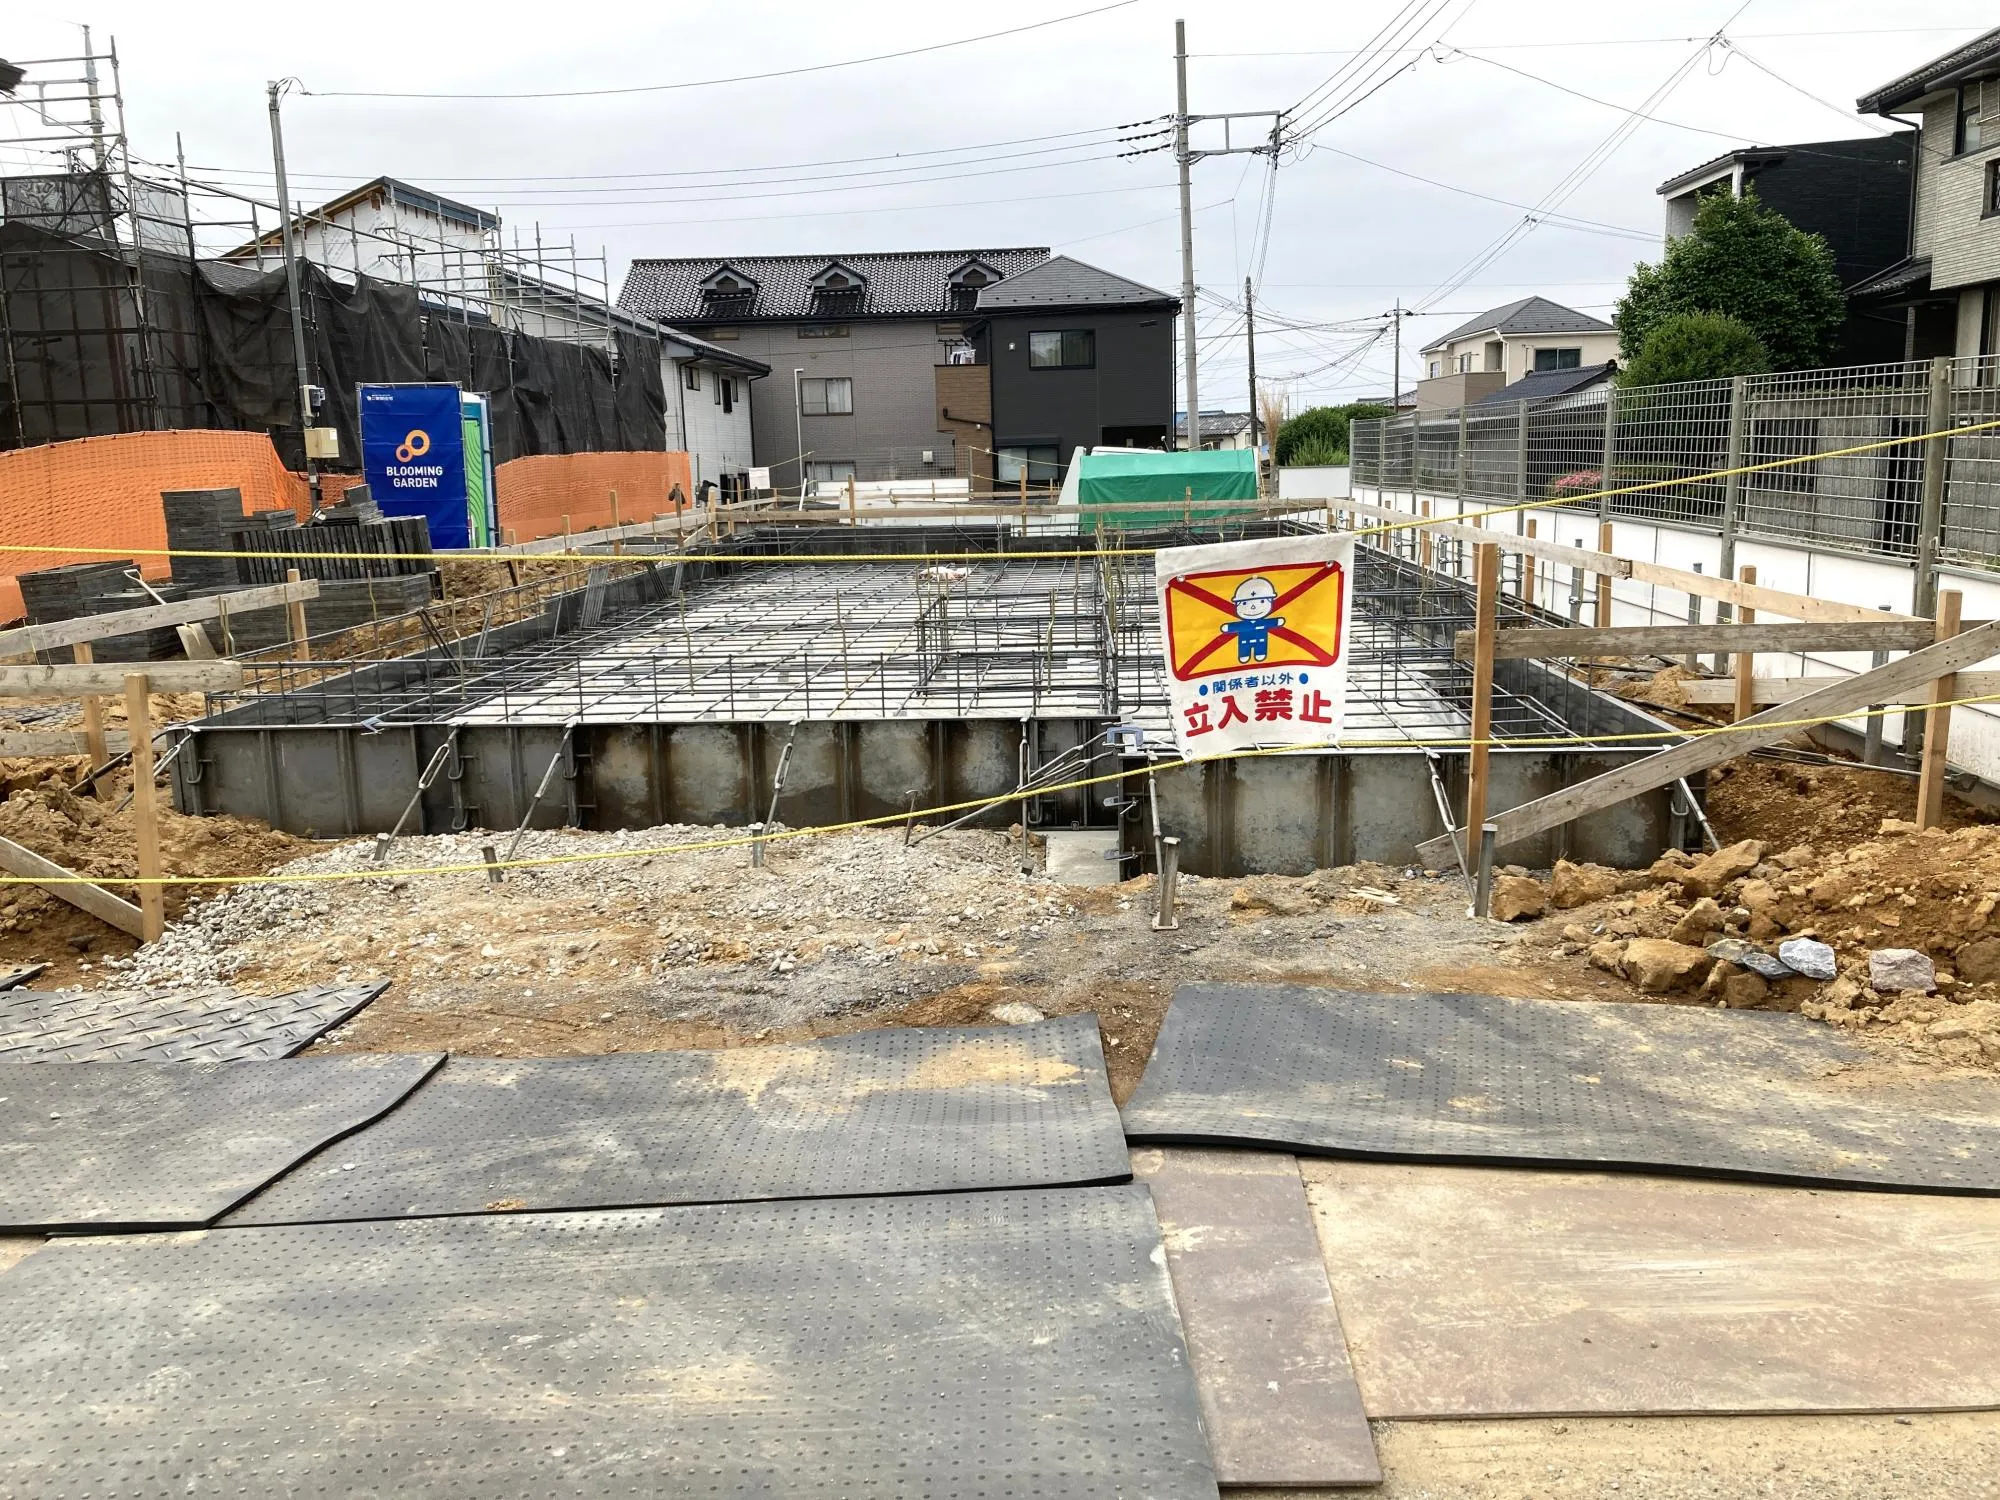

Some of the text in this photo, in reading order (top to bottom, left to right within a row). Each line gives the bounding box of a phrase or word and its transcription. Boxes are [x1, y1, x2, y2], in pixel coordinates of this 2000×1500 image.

[386, 466, 443, 476] BLOOMING
[393, 477, 438, 488] GARDEN
[1212, 672, 1294, 694] 関係者以外
[1184, 688, 1333, 738] 立入禁止
